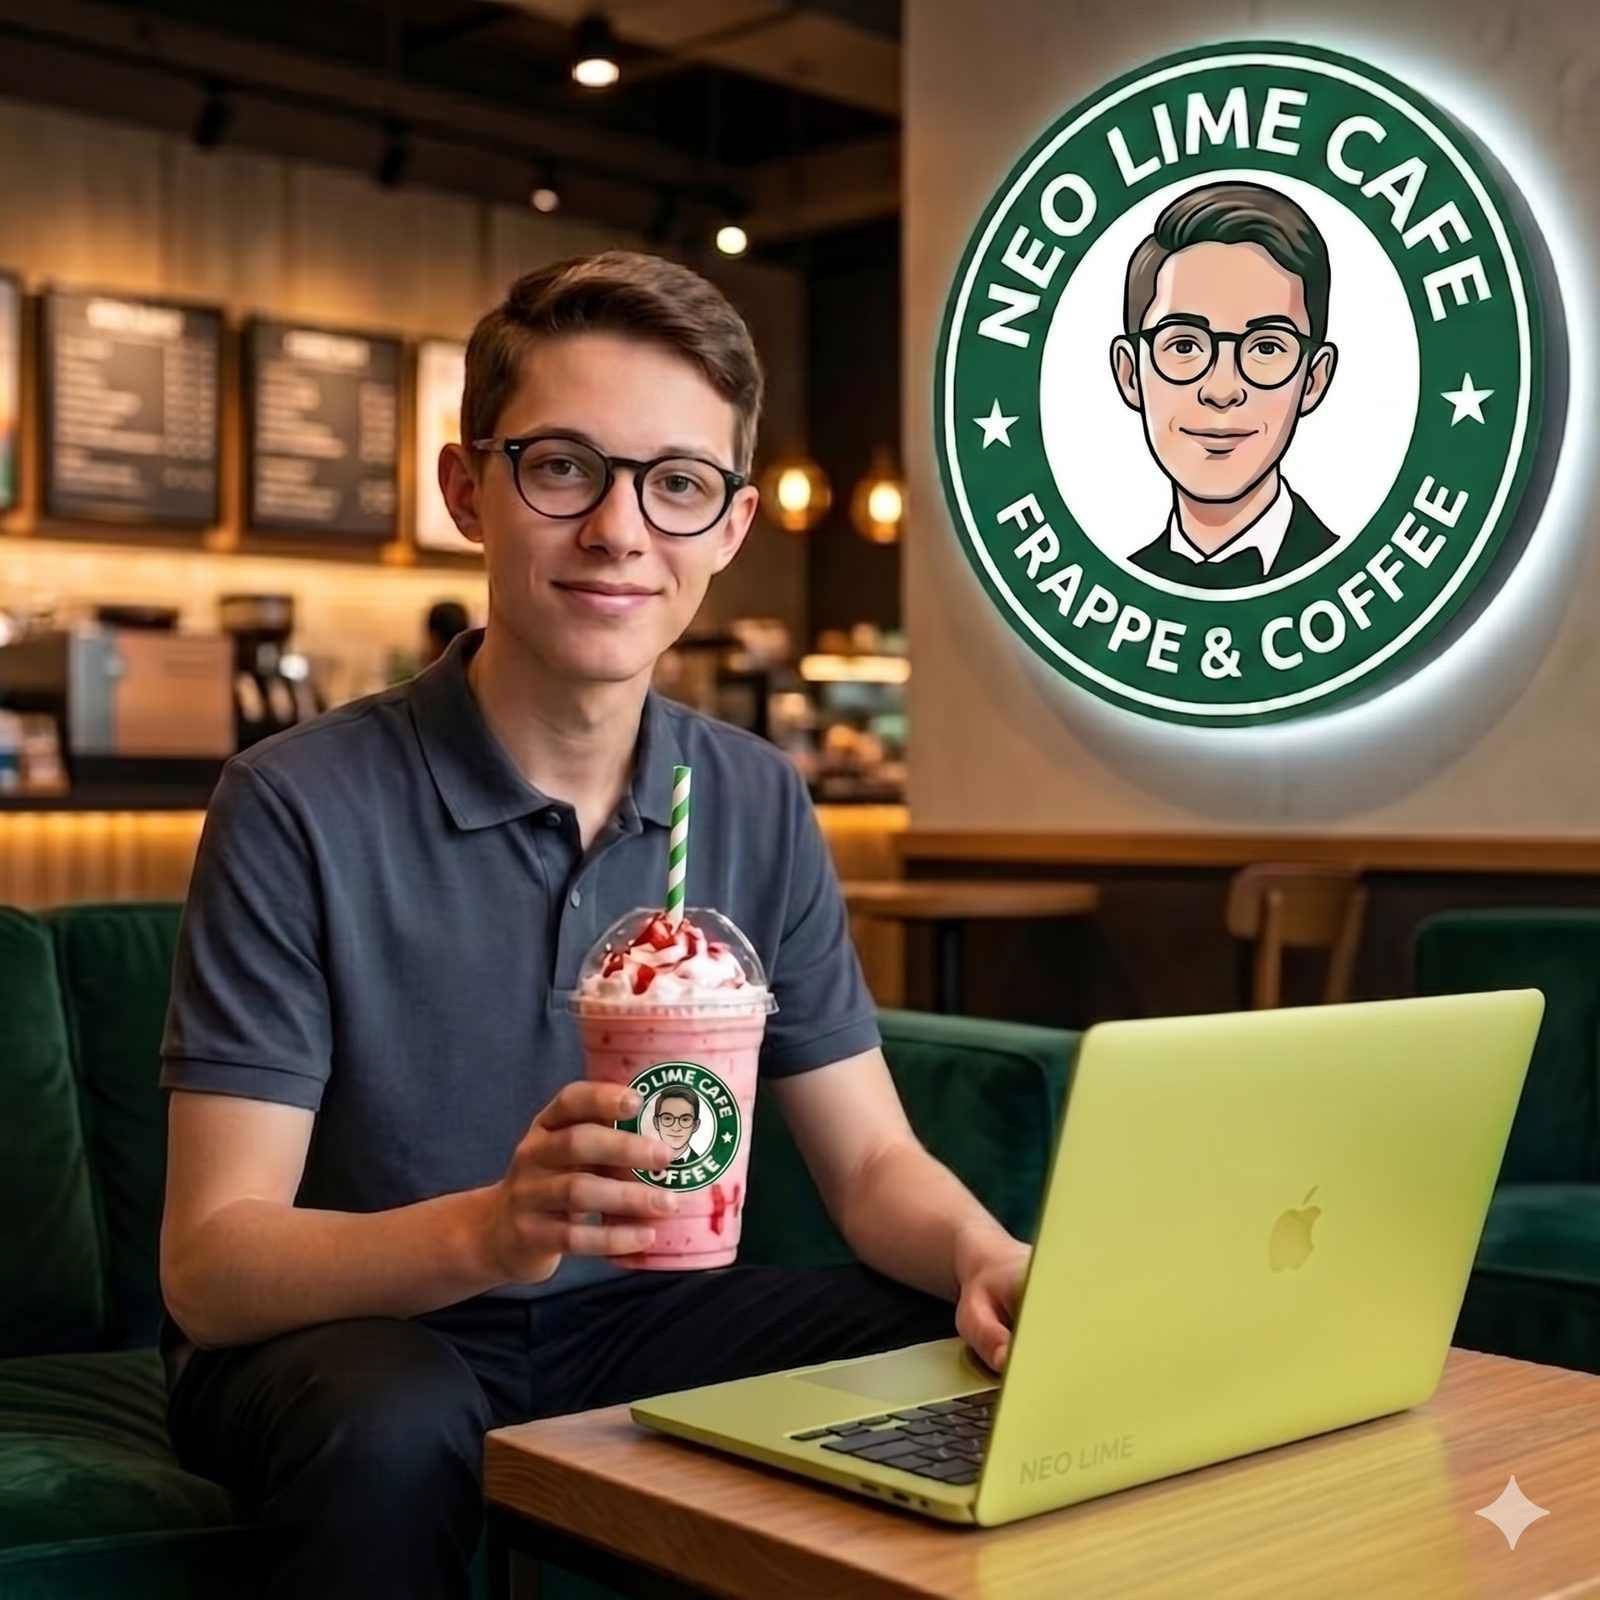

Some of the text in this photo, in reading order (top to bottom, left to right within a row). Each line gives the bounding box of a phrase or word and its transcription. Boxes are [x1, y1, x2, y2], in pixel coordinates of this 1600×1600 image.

[977, 86, 1494, 349] NEO LIME CAFE
[996, 475, 1470, 679] FRAPPE & COFFEE
[650, 1068, 734, 1119] LIME CAFE
[637, 1154, 722, 1186] OFFEE
[1019, 1434, 1135, 1485] NEO LIME
